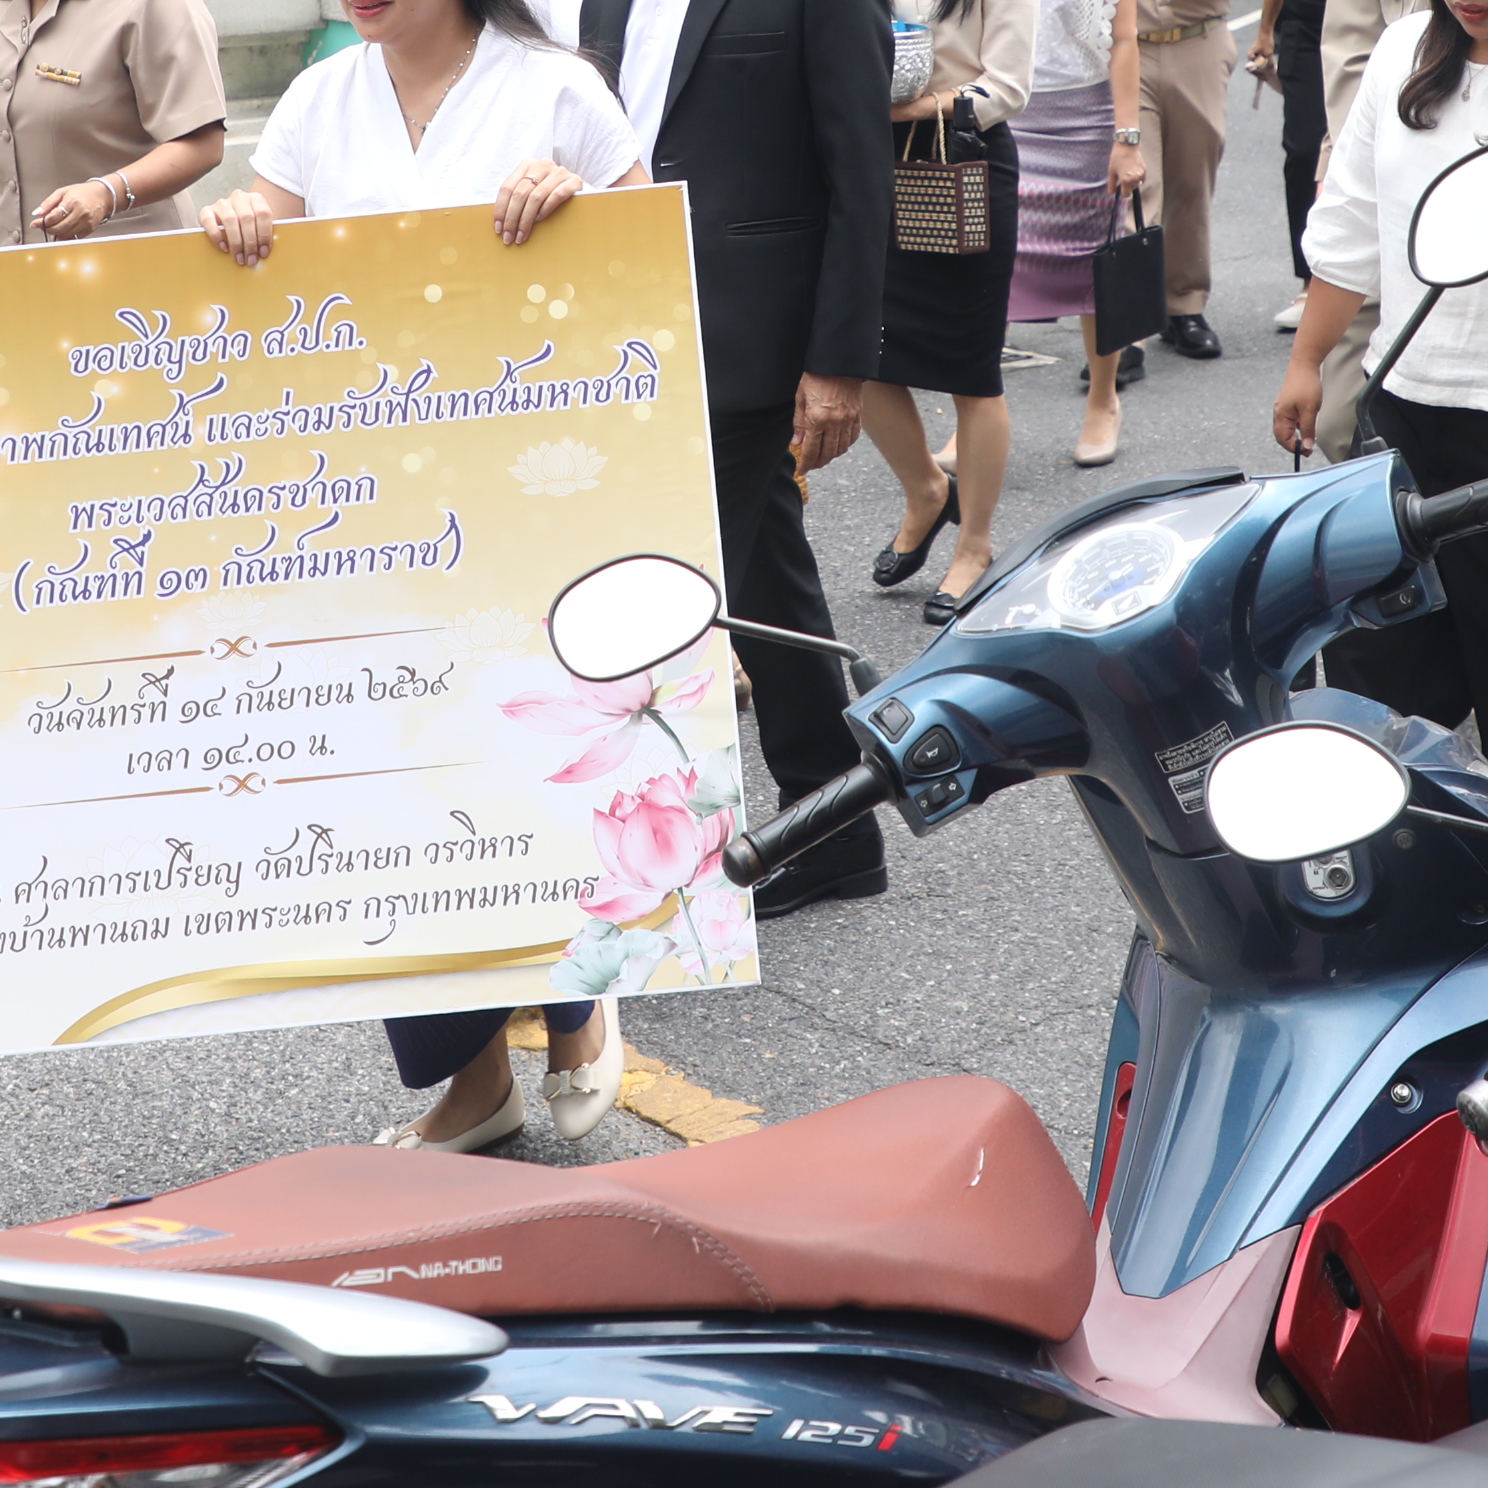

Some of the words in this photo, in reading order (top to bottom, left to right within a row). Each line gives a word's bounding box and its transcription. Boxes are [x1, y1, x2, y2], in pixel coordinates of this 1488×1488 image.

[71, 306, 250, 381] ขอเชิญชาว
[266, 295, 365, 355] ส.ป.ก.
[208, 342, 658, 441] และร่วมรับฟังเทศน์มหาชาติ
[72, 452, 375, 530] พระเวสสันดรชาดก
[157, 567, 207, 597] ๑๓
[28, 666, 174, 735] วันจันทร์ที่
[179, 687, 226, 723] ๑๔
[236, 662, 354, 715] กันยายน
[361, 663, 454, 700] ๒๕๖๙
[127, 746, 189, 774] เวลา
[309, 734, 335, 757] น.
[15, 838, 242, 905] ศาลาการเปรียญ
[256, 824, 411, 881] วัดปรินายก
[424, 810, 534, 865] วรวิหาร
[184, 898, 352, 937] เขตพระนคร
[363, 875, 599, 946] กรุงเทพมหานคร
[467, 1394, 774, 1433] WAVE
[781, 1418, 903, 1452] 125i
